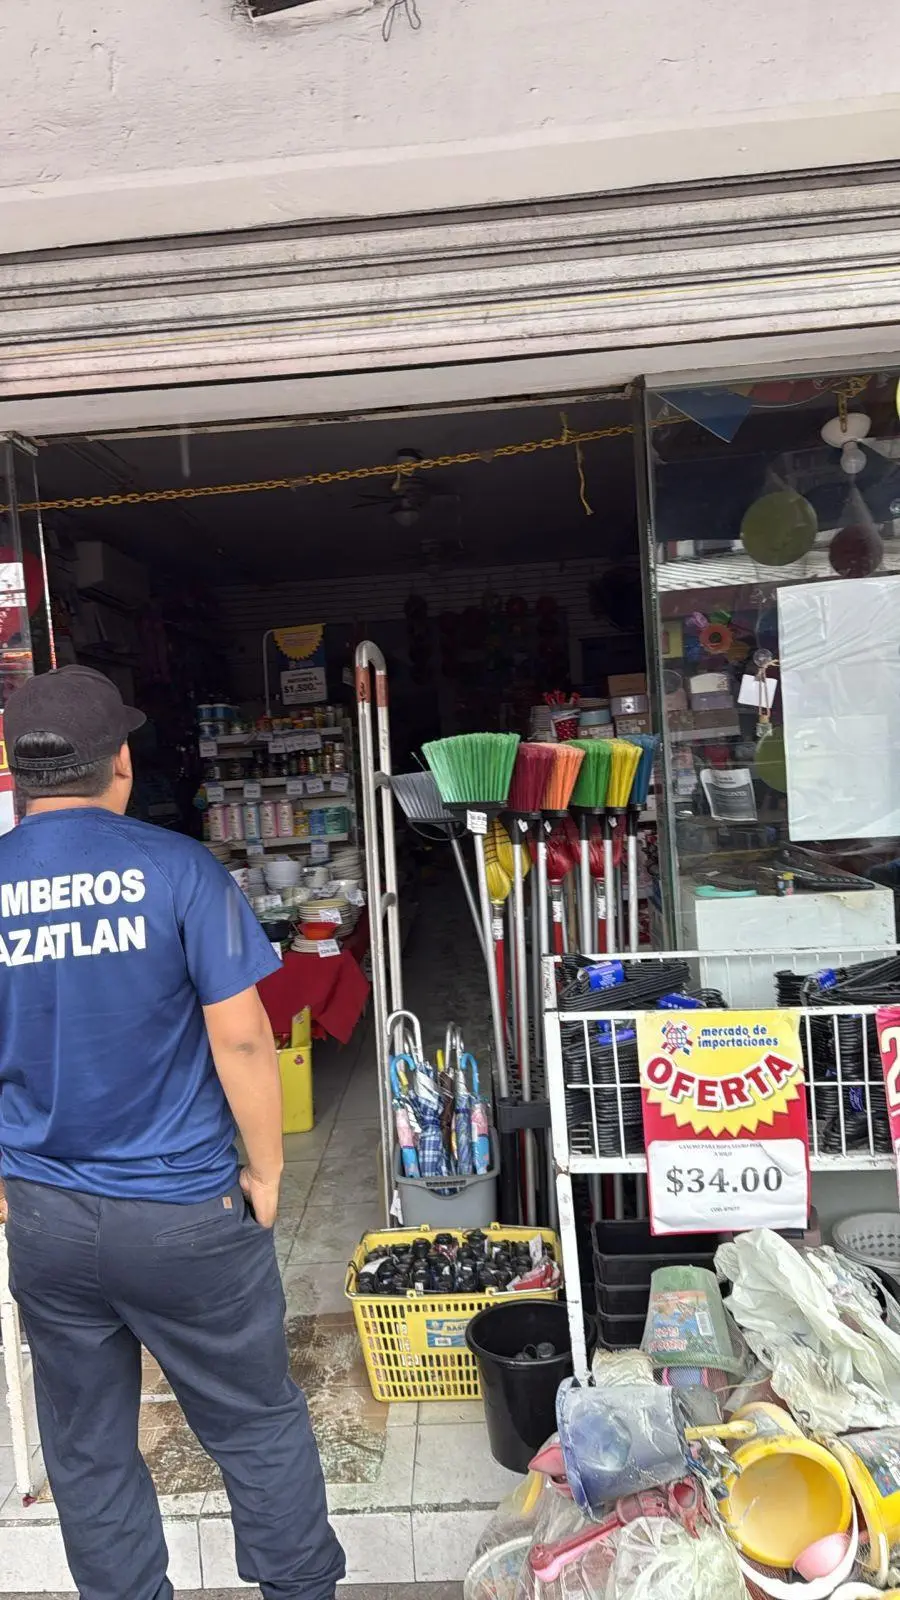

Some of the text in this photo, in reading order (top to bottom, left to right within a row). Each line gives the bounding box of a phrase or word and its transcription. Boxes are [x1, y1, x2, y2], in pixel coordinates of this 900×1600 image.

[1, 868, 146, 918] MBEROS
[697, 1035, 779, 1050] importaciones
[701, 1024, 767, 1037] mercado de
[645, 1053, 795, 1109] OFERTA
[666, 1165, 783, 1197] $34.00
